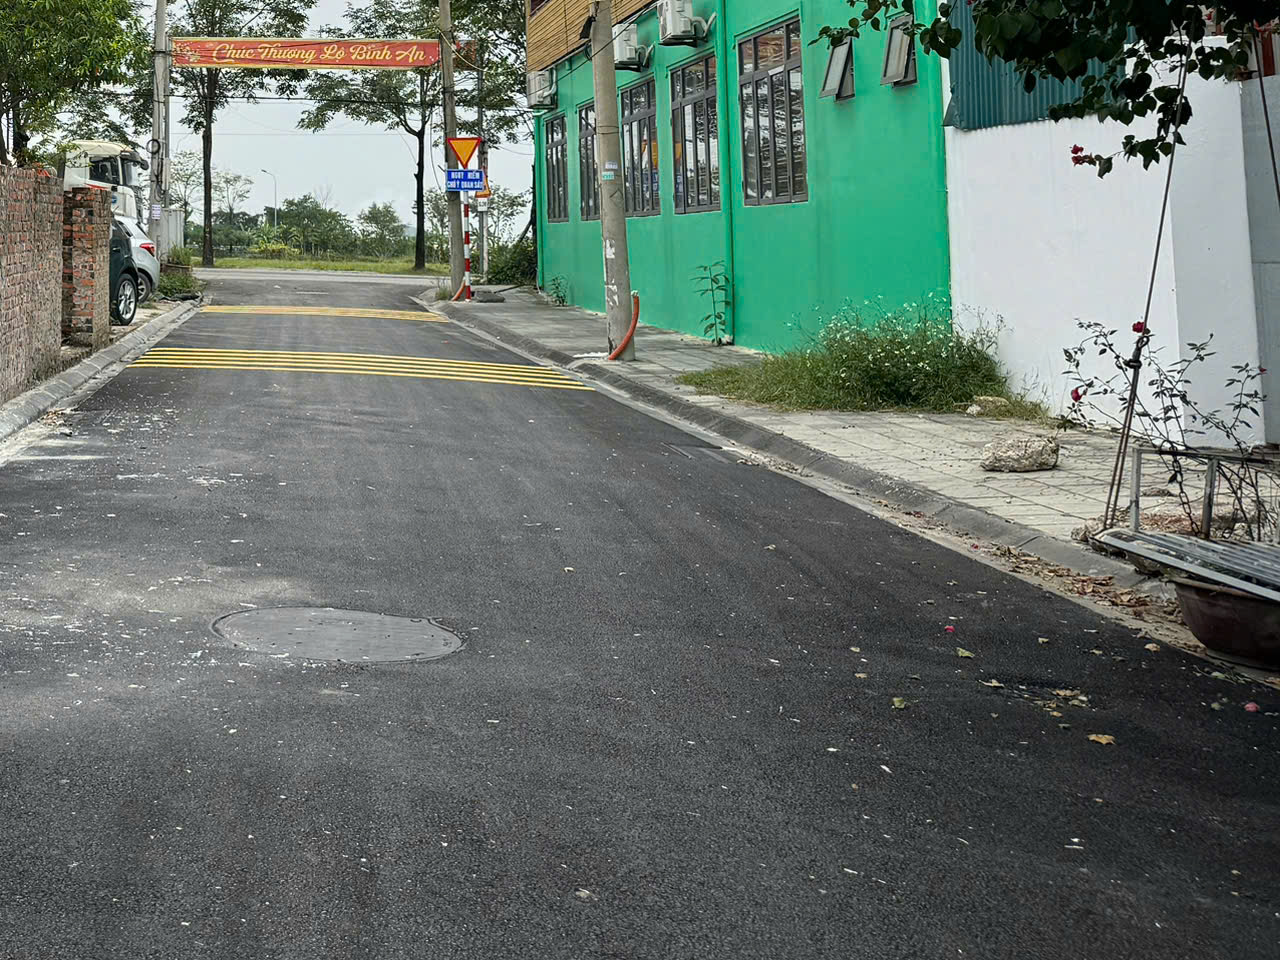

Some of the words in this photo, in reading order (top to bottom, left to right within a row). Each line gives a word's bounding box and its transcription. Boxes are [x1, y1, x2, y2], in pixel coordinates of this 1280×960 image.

[213, 43, 255, 62] Chúc
[257, 43, 317, 63] Thượng
[320, 44, 345, 62] Lộ
[395, 45, 426, 62] An
